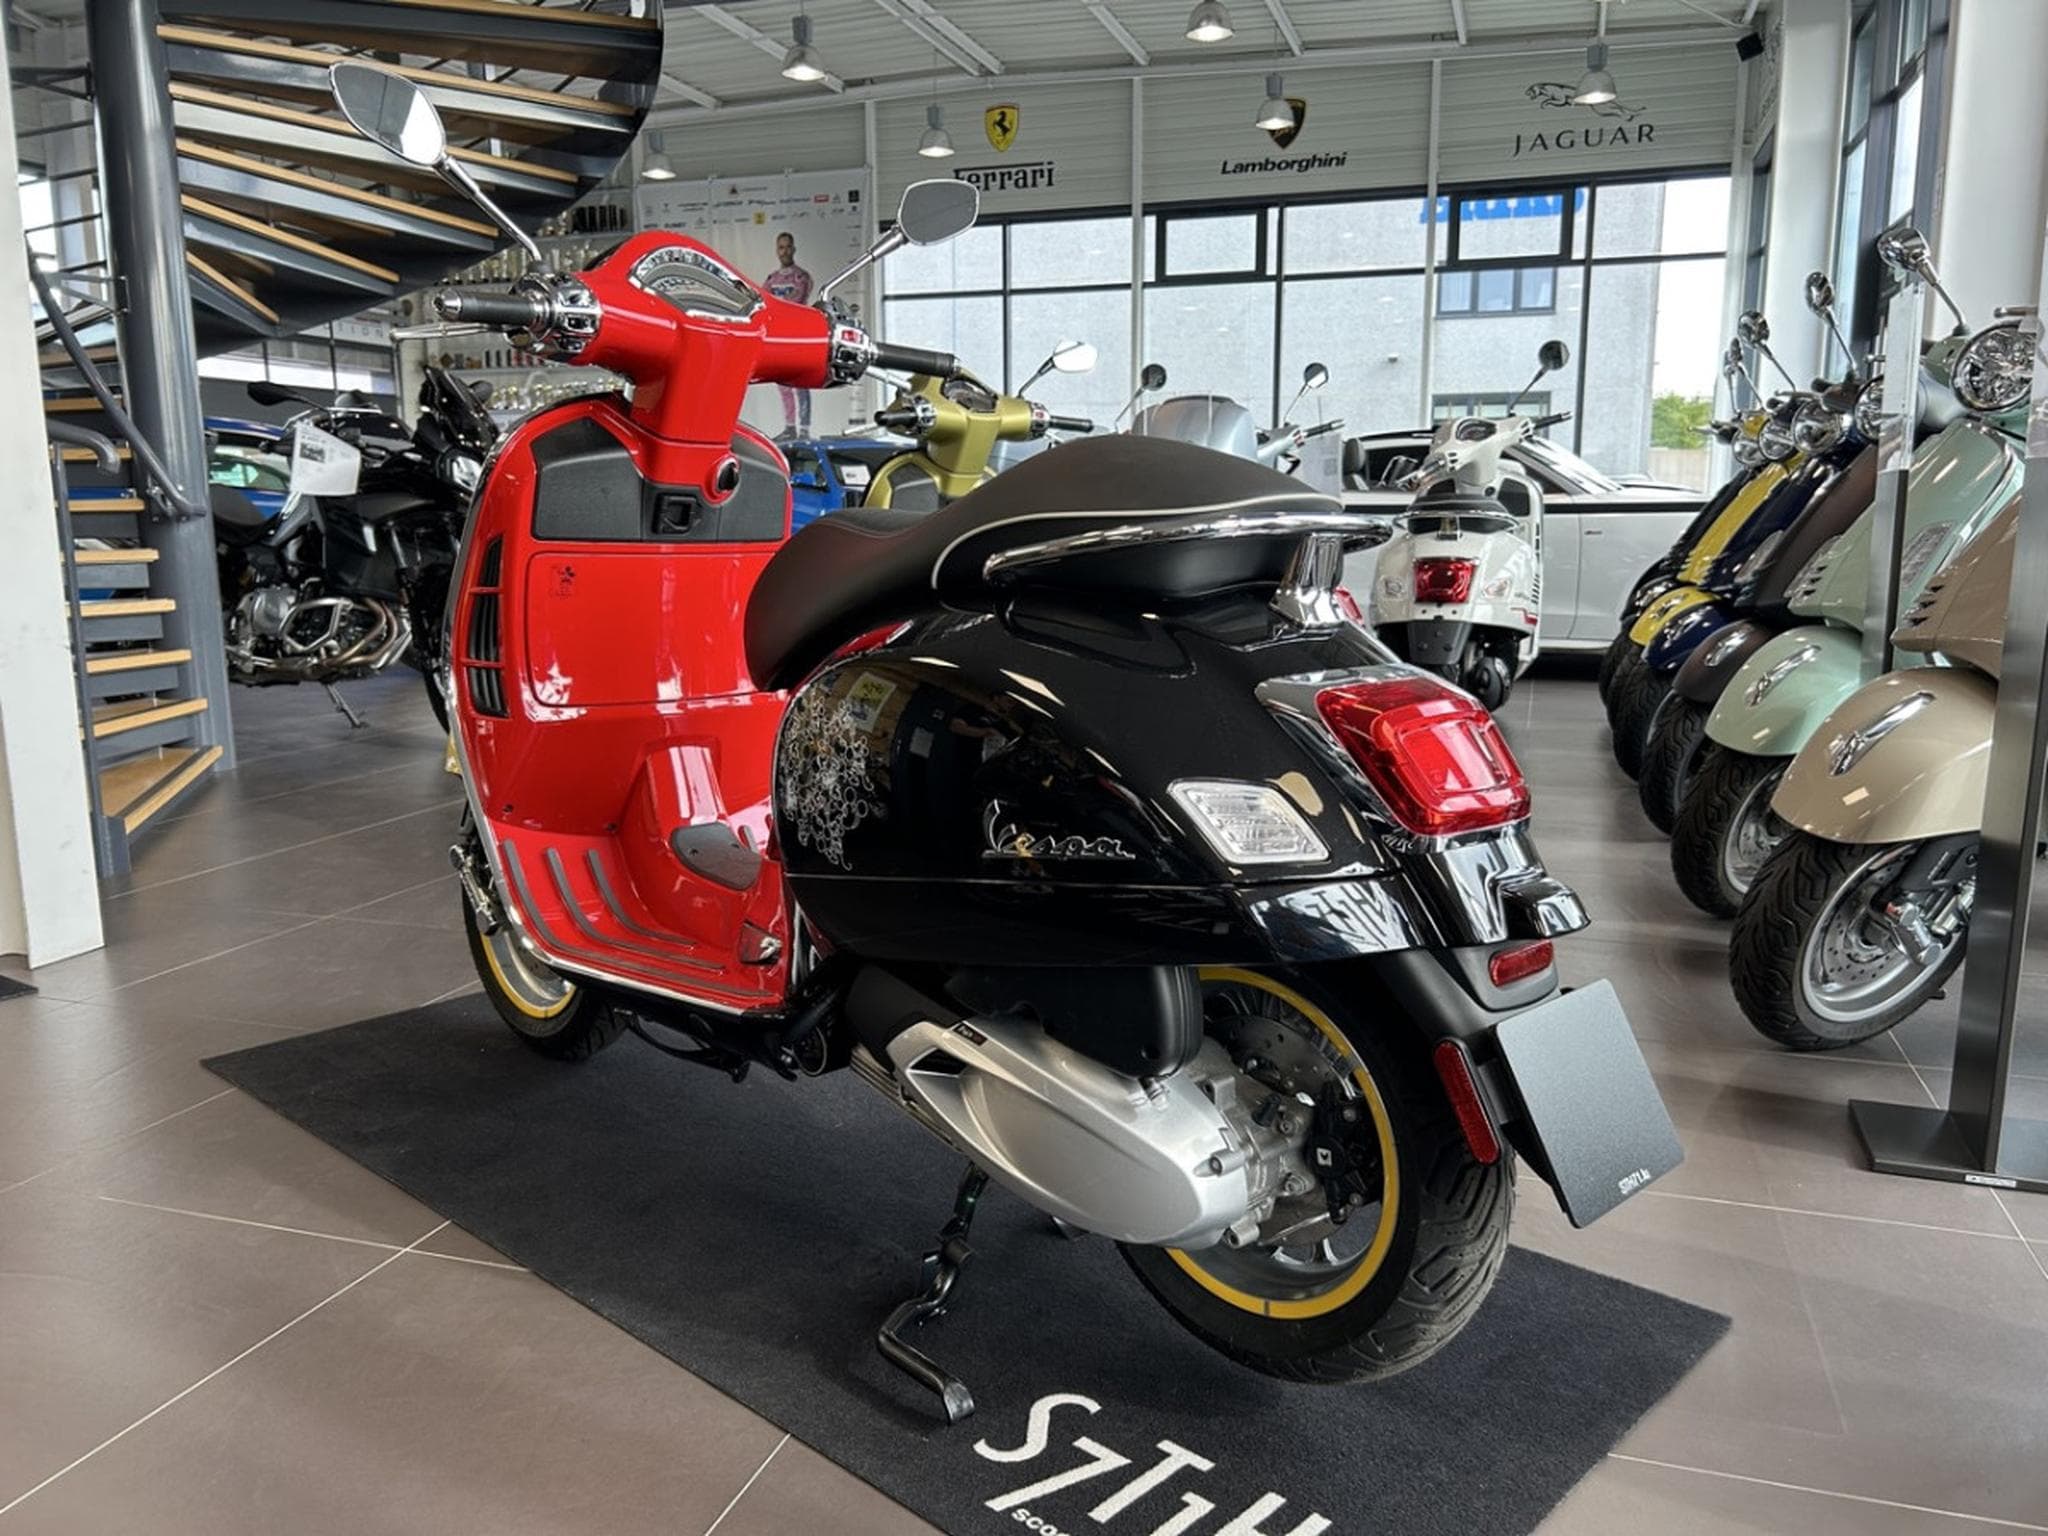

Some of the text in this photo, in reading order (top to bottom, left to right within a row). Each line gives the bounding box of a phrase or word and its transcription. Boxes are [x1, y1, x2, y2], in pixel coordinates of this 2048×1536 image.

[1514, 124, 1655, 157] JAGUAR
[953, 161, 1054, 191] Ferrari
[1221, 152, 1348, 174] Lamborghini
[982, 799, 1136, 858] Vespa
